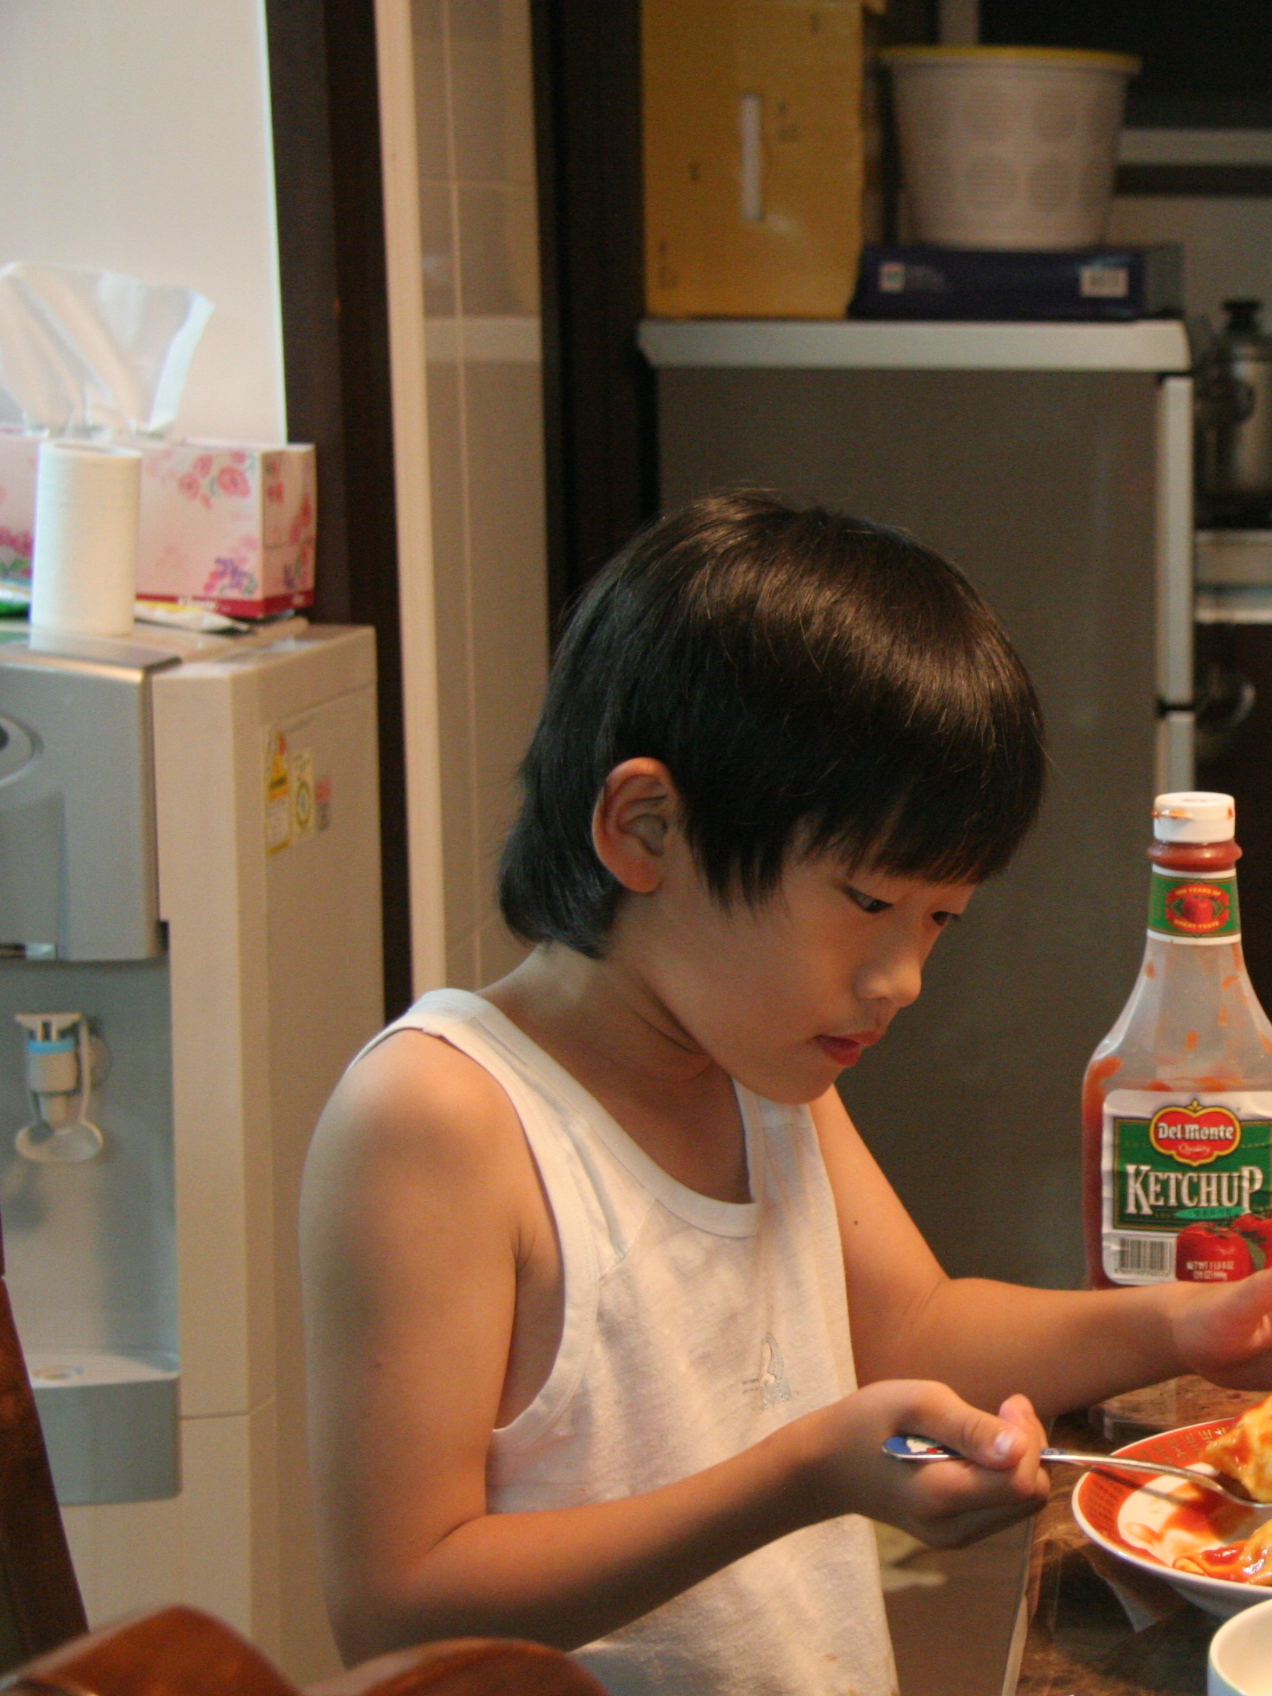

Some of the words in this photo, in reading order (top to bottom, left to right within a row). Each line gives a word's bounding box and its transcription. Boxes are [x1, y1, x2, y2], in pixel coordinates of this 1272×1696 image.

[1157, 1122, 1181, 1140] Del
[1184, 1123, 1235, 1141] Monte
[1178, 1143, 1211, 1154] Quality
[1125, 1164, 1264, 1216] KETCHUP
